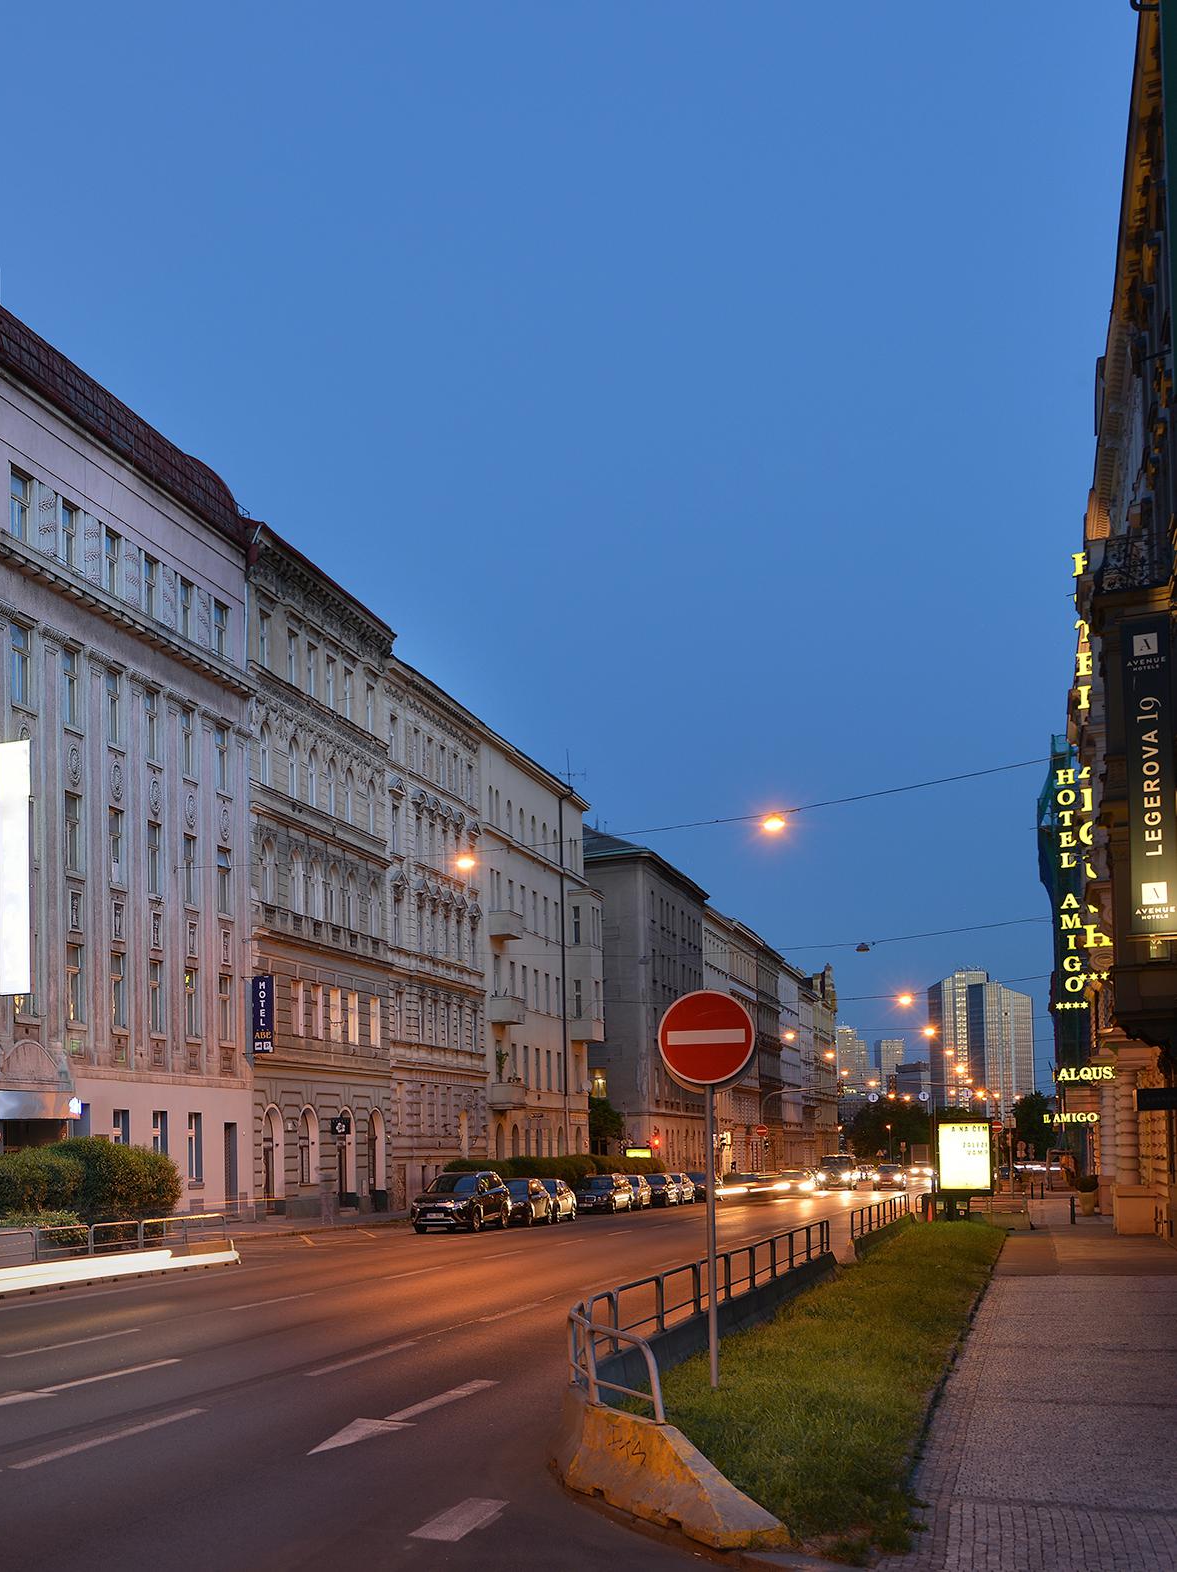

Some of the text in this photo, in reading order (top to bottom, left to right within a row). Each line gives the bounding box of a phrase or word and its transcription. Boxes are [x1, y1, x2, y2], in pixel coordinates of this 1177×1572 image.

[1126, 656, 1166, 667] AVENUE
[1137, 697, 1162, 857] LEGEROVA 19
[1056, 768, 1084, 992] HOTEL AMIGO
[1135, 906, 1176, 915] AVENUE
[1052, 1111, 1098, 1123] AMIGO
